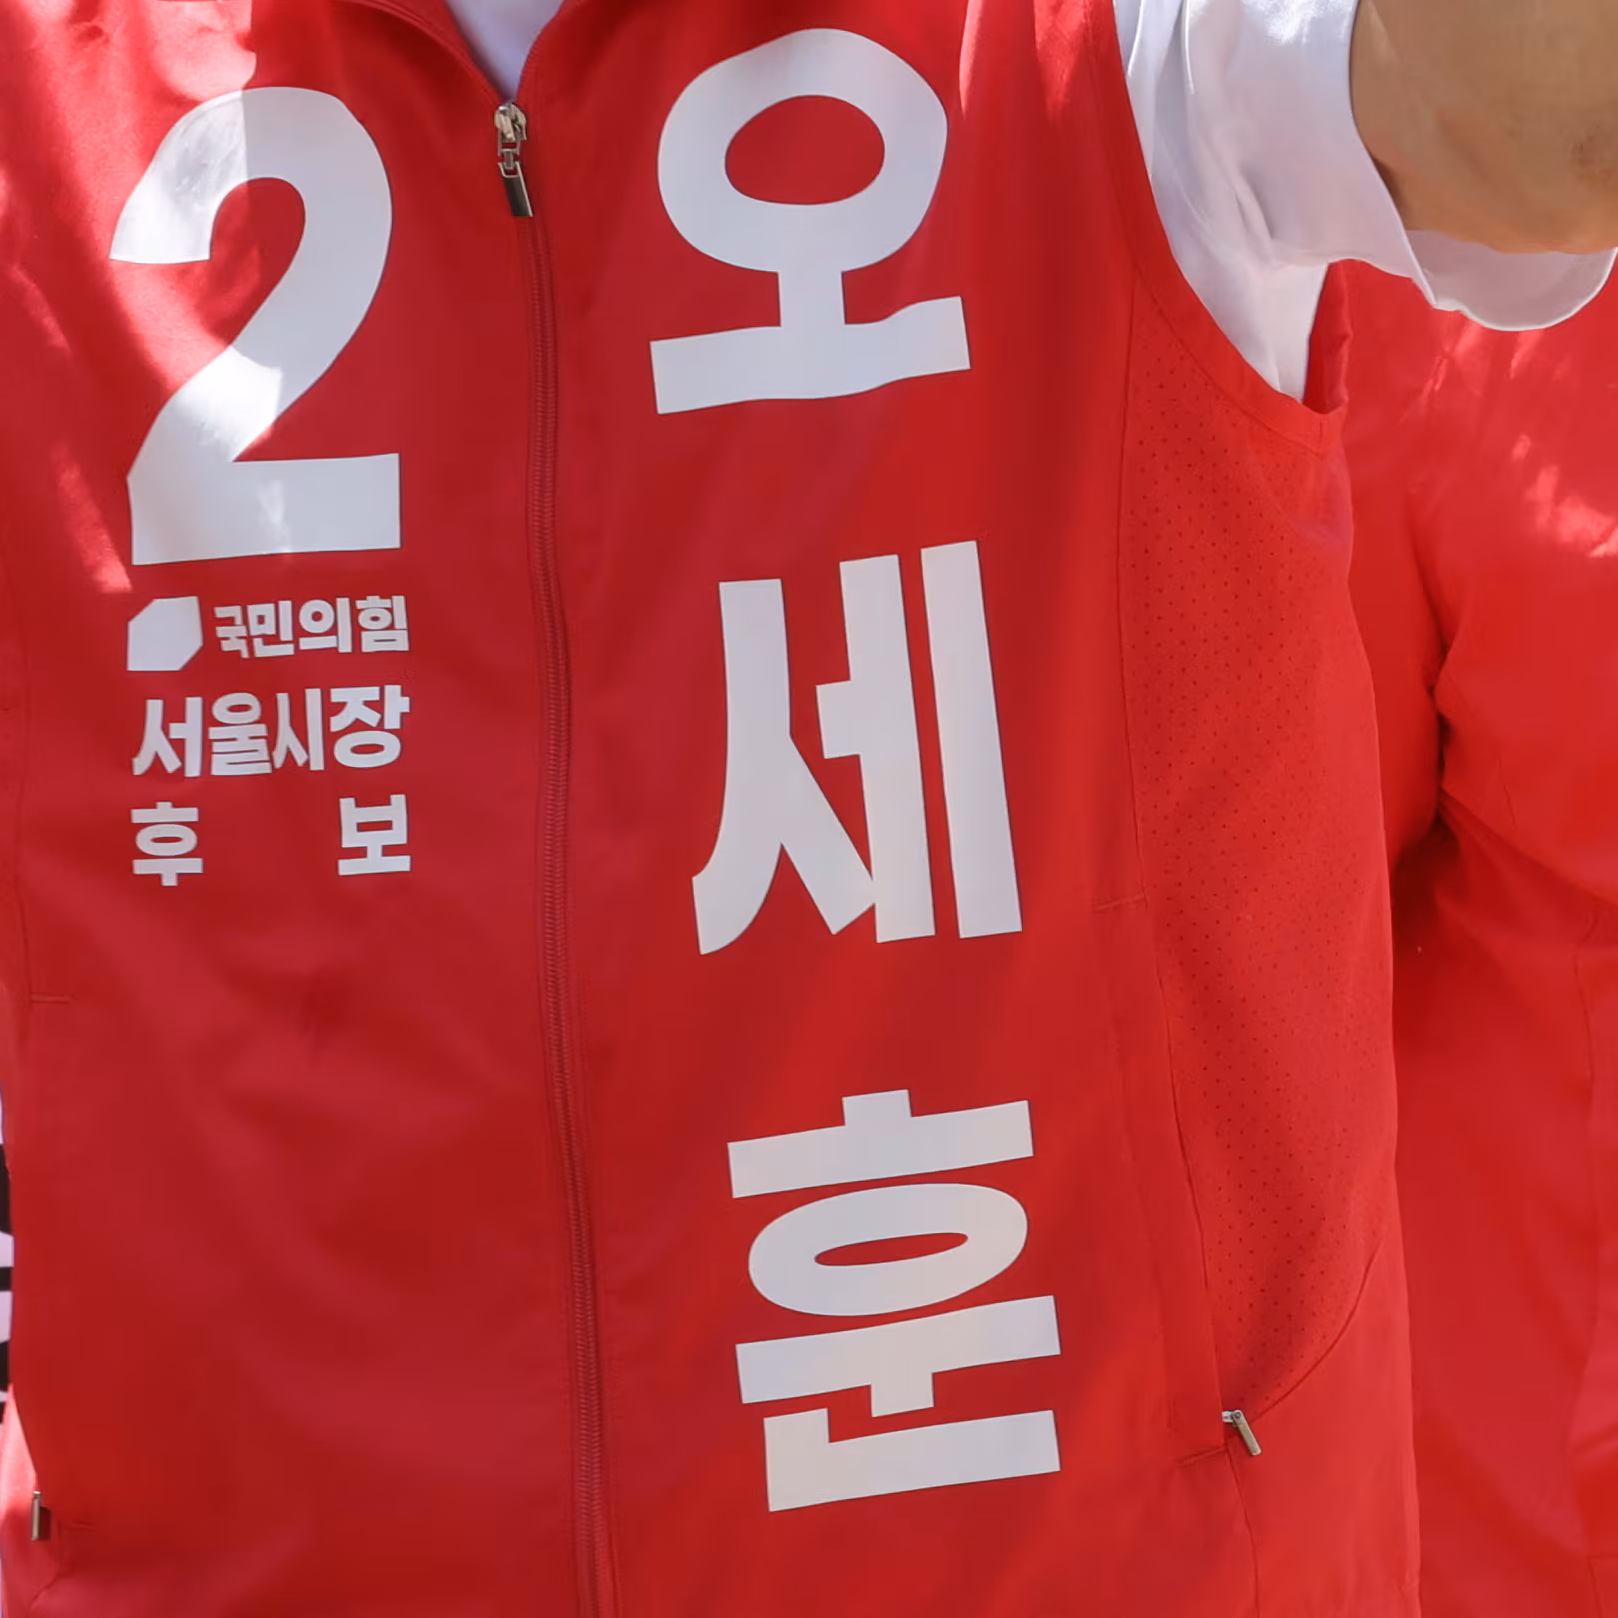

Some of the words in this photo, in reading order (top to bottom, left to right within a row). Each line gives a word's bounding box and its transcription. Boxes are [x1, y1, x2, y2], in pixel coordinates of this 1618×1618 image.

[109, 86, 402, 566] 2
[131, 684, 411, 779] 서울시장
[214, 594, 411, 661] 국민의힘
[650, 27, 1061, 1513] 오세훈
